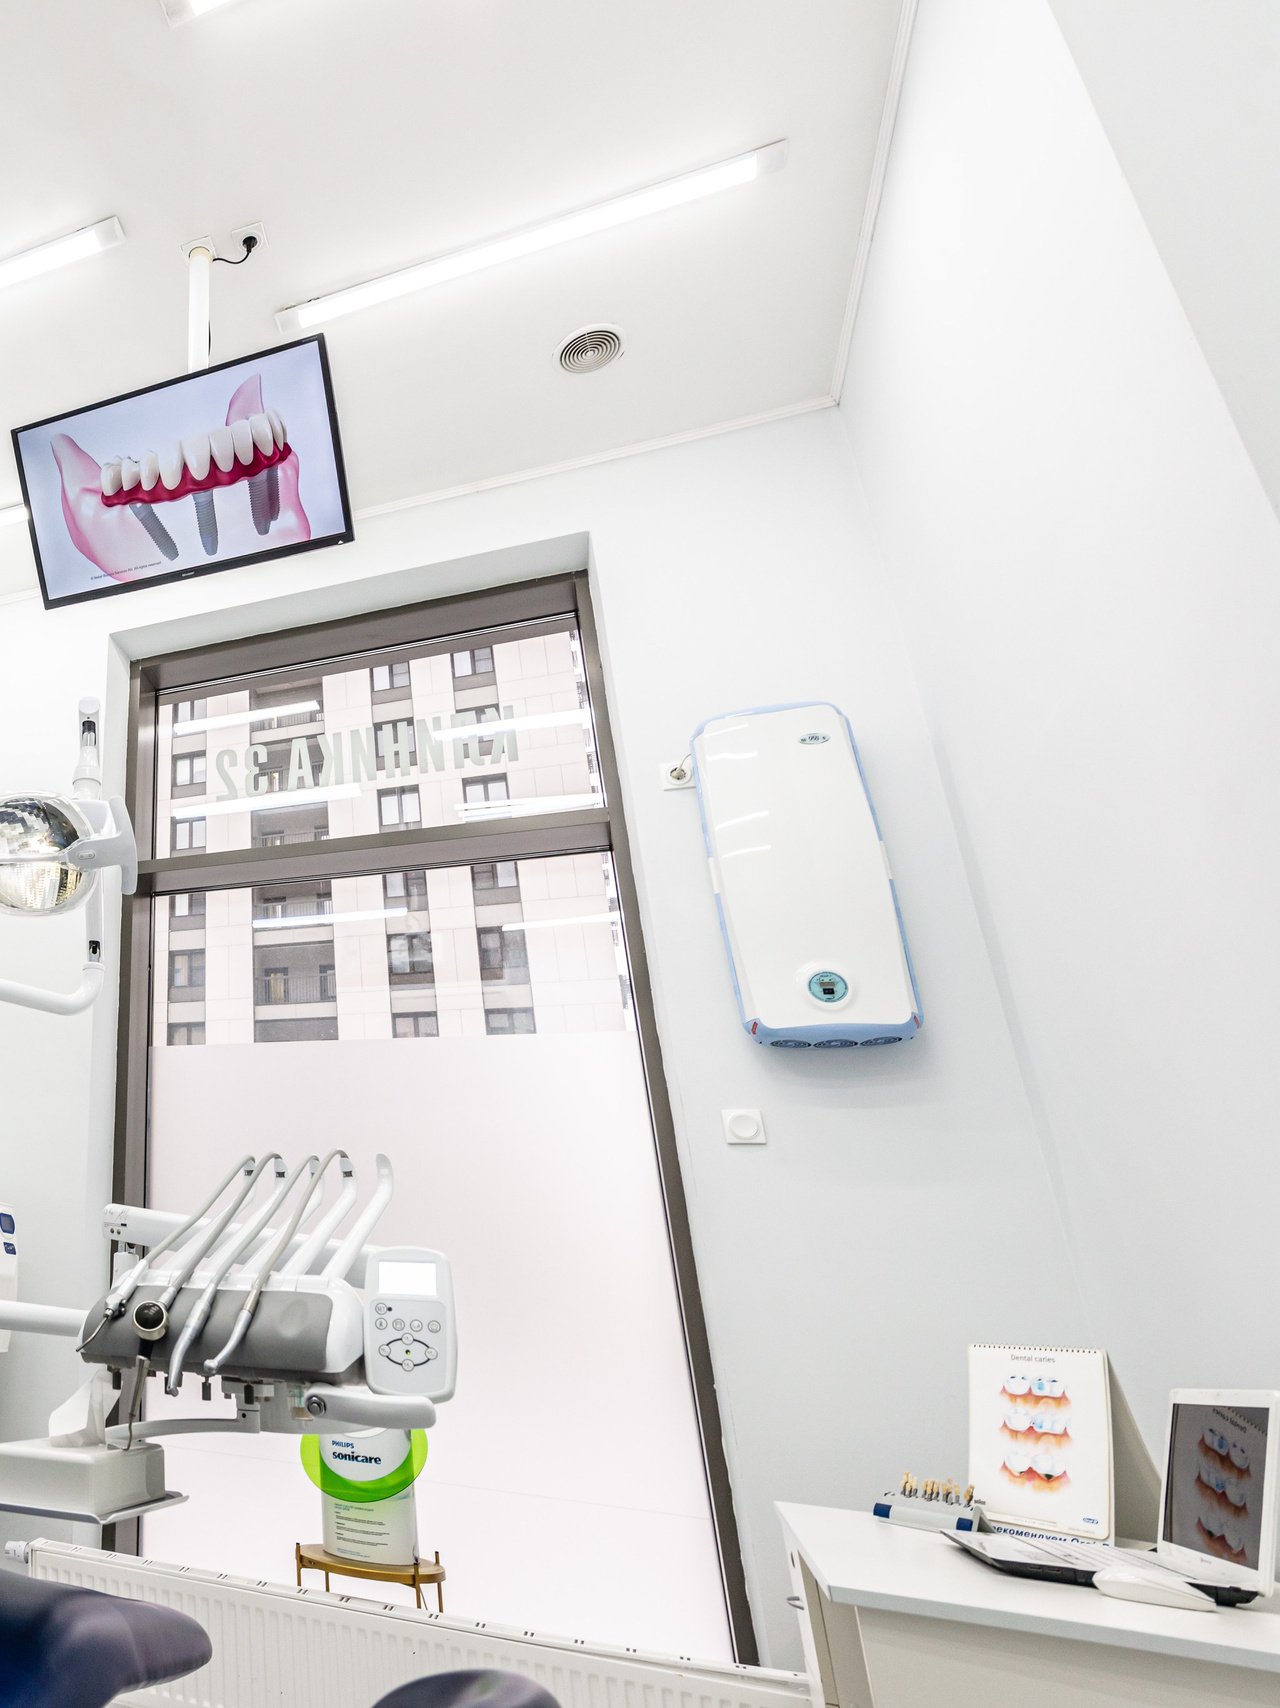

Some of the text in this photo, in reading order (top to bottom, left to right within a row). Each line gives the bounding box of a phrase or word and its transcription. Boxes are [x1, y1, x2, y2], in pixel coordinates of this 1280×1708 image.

[1010, 1354, 1056, 1364] Dental caries
[331, 1439, 355, 1449] PHILIPS
[332, 1451, 382, 1465] sonicare
